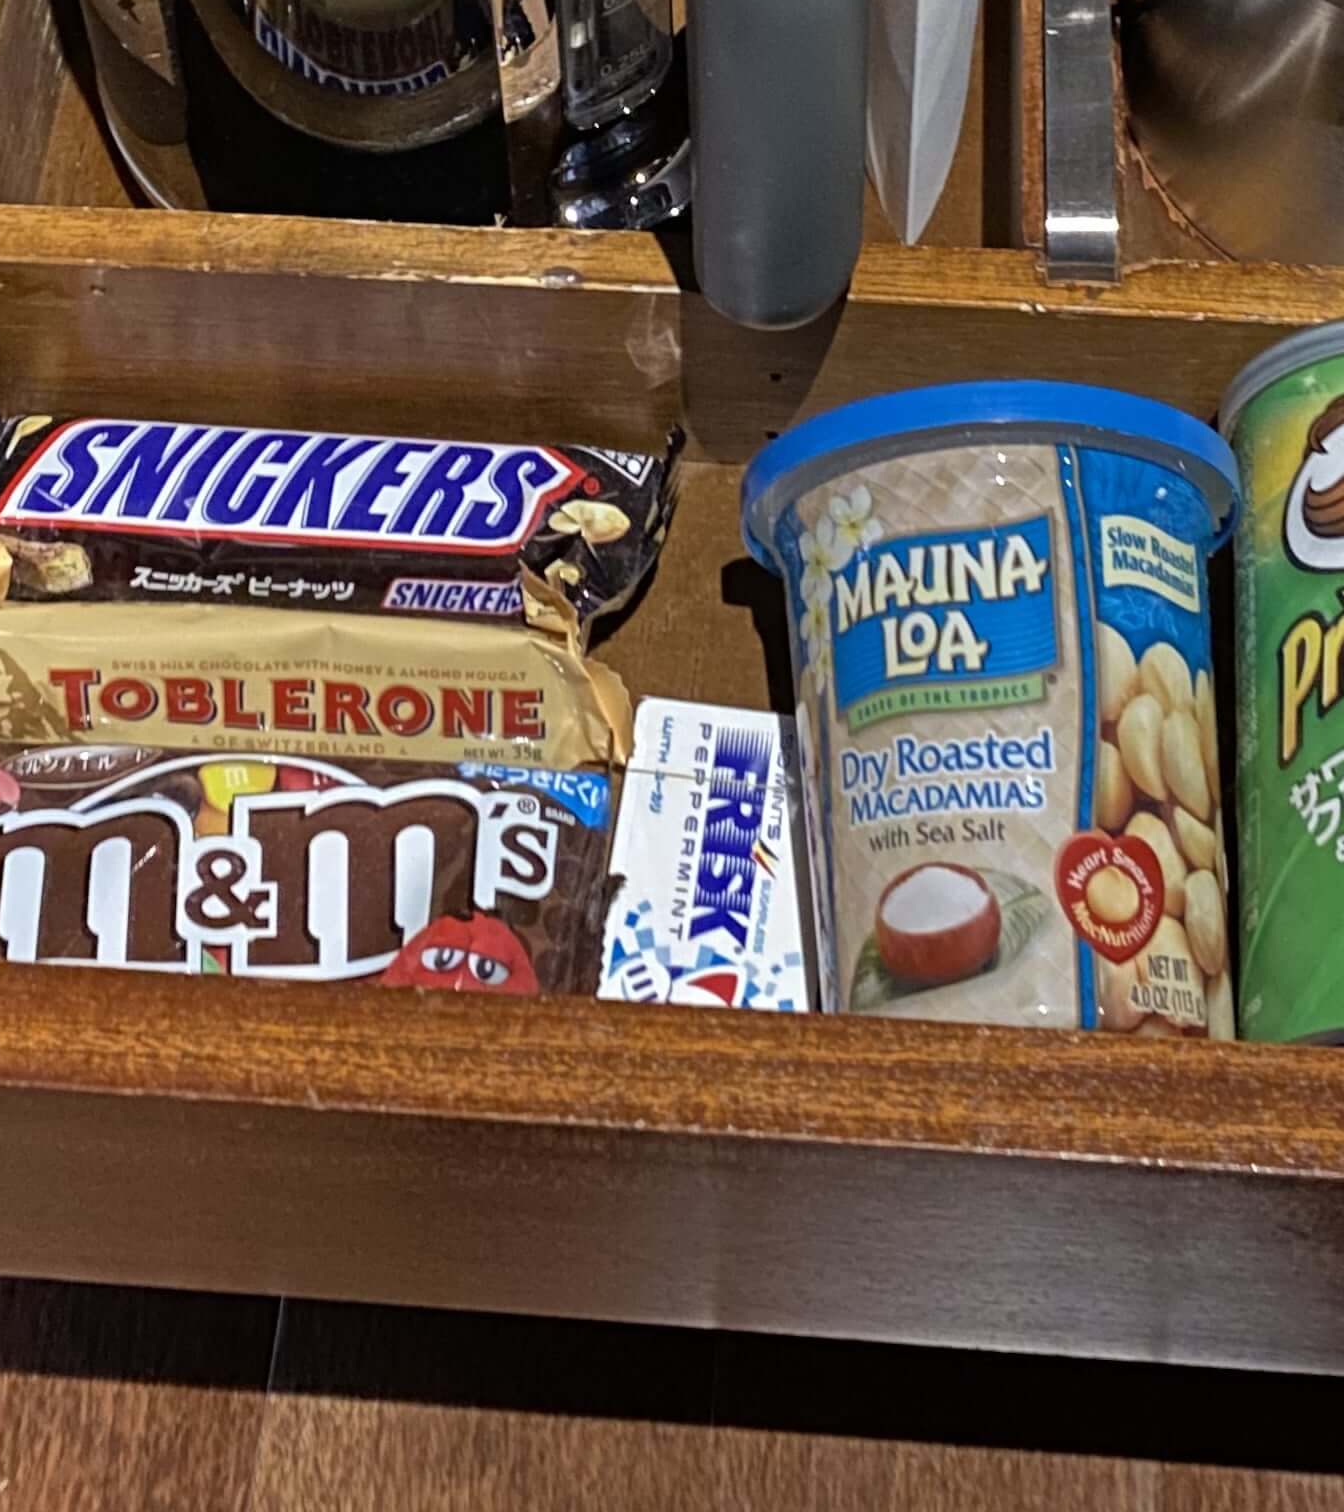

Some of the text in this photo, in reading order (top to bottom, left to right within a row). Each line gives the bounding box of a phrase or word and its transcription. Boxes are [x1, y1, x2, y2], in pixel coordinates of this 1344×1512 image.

[18, 421, 560, 544] SNICKERS
[1106, 525, 1195, 577] Slow Roasted
[1112, 549, 1196, 600] Macadamias
[129, 566, 355, 601] スニッカーズ ピーナッツ
[834, 534, 1047, 634] MAUNA
[882, 610, 988, 678] LOA
[111, 658, 527, 682] SWISS MILK CHOCOLATE WITH HONEY & ALMOND NOUGAT
[47, 666, 547, 742] TOBLERONE
[858, 683, 1031, 722] TASTE OF THE TROPICS
[212, 735, 385, 755] OF SWITZERLAND
[463, 747, 485, 759] NET
[511, 744, 543, 761] 35g
[657, 715, 674, 764] WITH
[841, 729, 1053, 790] Dry Roasted
[850, 778, 1045, 825] MACADAMIAS
[668, 721, 714, 942] PEPPERMINT
[687, 724, 775, 950] FRISK
[869, 817, 1006, 853] with Sea Salt
[1066, 846, 1154, 896] Heart Smart
[1147, 954, 1190, 982] NET WT
[1130, 983, 1152, 1008] 4.0
[1152, 985, 1170, 1011] OZ
